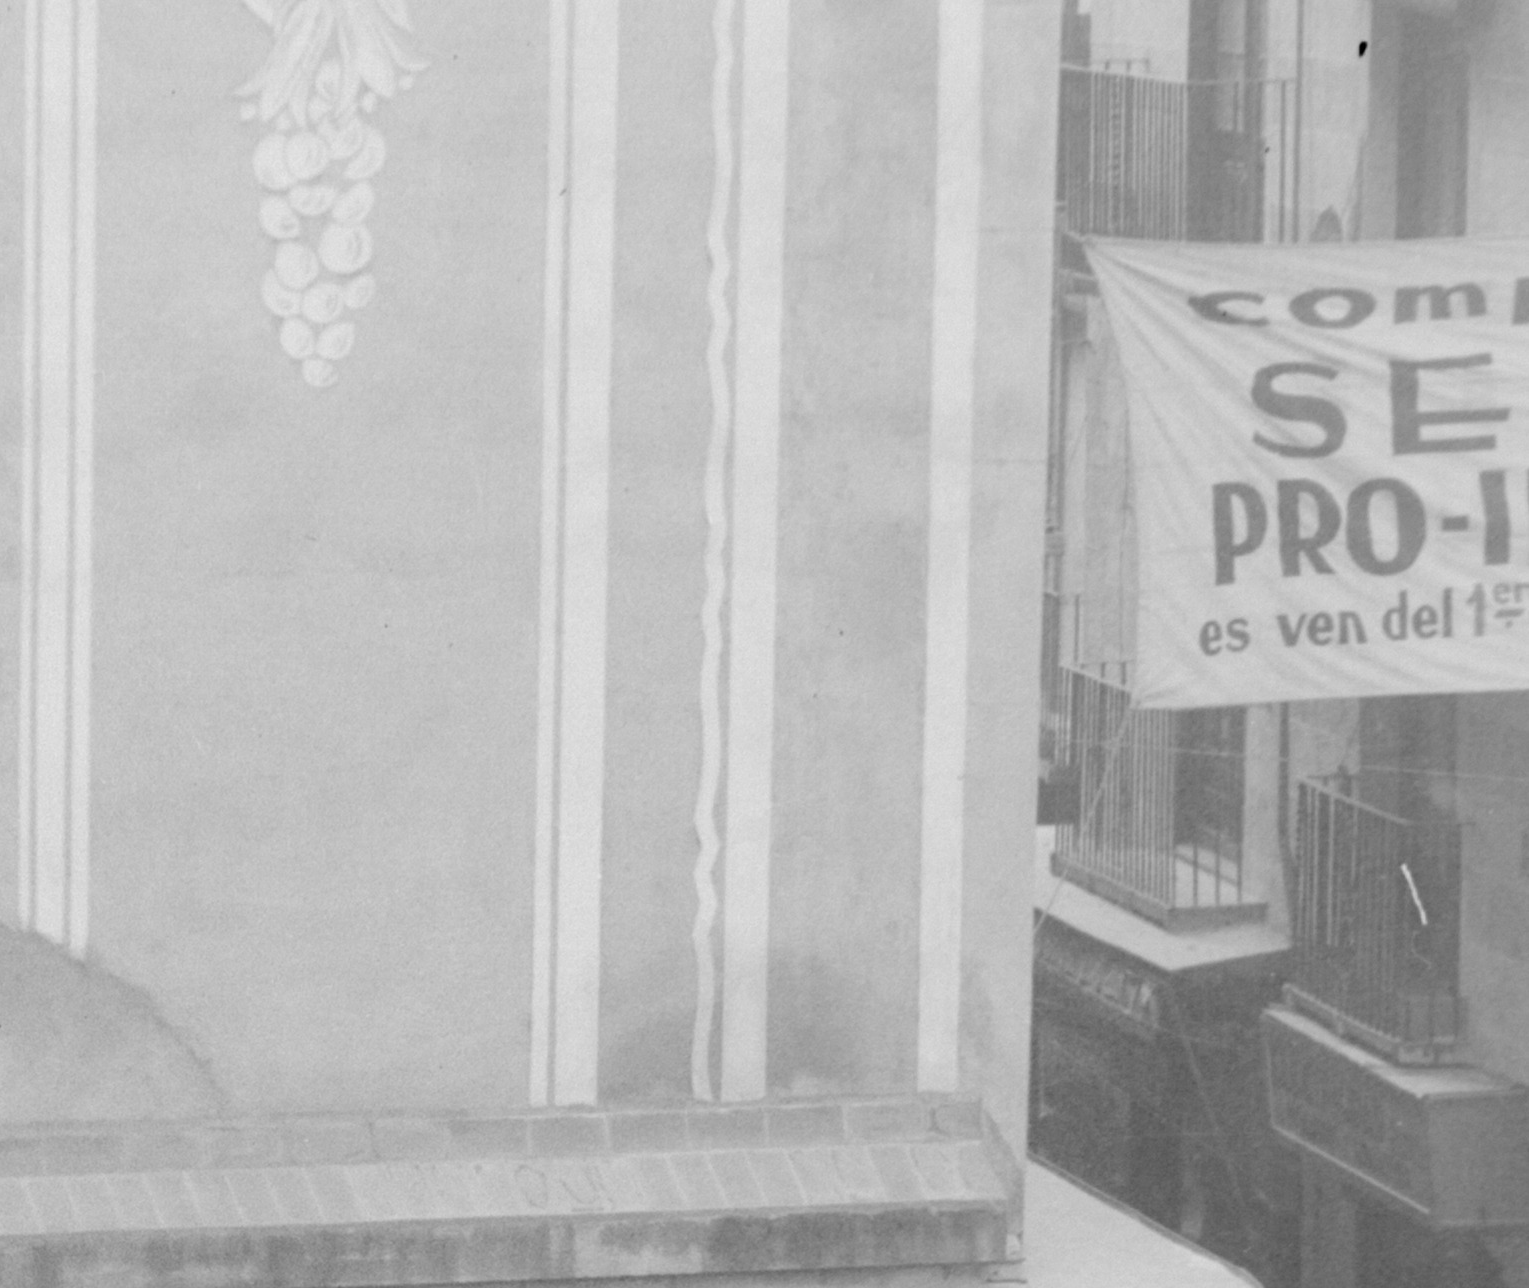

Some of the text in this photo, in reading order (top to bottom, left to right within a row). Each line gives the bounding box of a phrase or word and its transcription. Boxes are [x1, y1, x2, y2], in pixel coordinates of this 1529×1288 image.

[1212, 469, 1529, 586] PRO-I
[1199, 617, 1251, 656] es
[1277, 605, 1368, 648] ven
[1381, 586, 1454, 641] del
